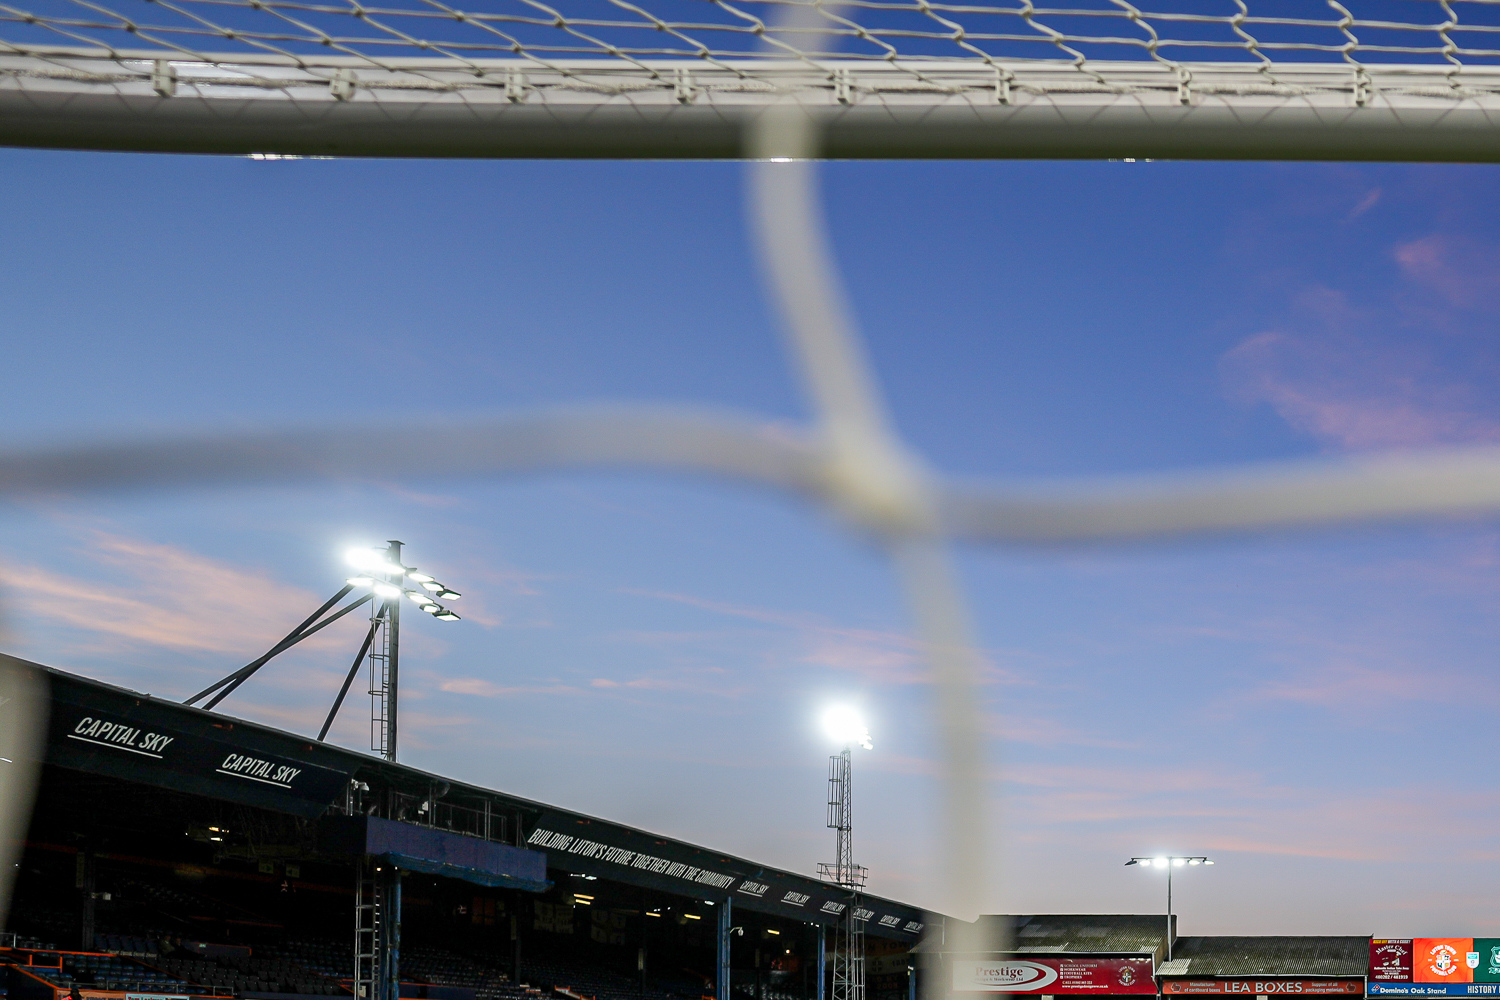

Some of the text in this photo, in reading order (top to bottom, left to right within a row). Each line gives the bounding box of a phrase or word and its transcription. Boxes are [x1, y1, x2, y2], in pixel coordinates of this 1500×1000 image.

[74, 717, 174, 752] CAPITAL SKY
[222, 754, 301, 783] CAPITAL SKY
[527, 828, 736, 890] BUILDING LUTON'S FUTURE TOGETHER WITH THE COMMUNITY
[1376, 945, 1408, 955] Master Chef
[1430, 945, 1457, 956] LUTON TOWN
[975, 967, 1024, 978] Prestige
[1430, 965, 1457, 976] FOOTBALL CLUB
[1224, 982, 1303, 993] LEA BOXES
[1467, 986, 1497, 994] HISTORY
